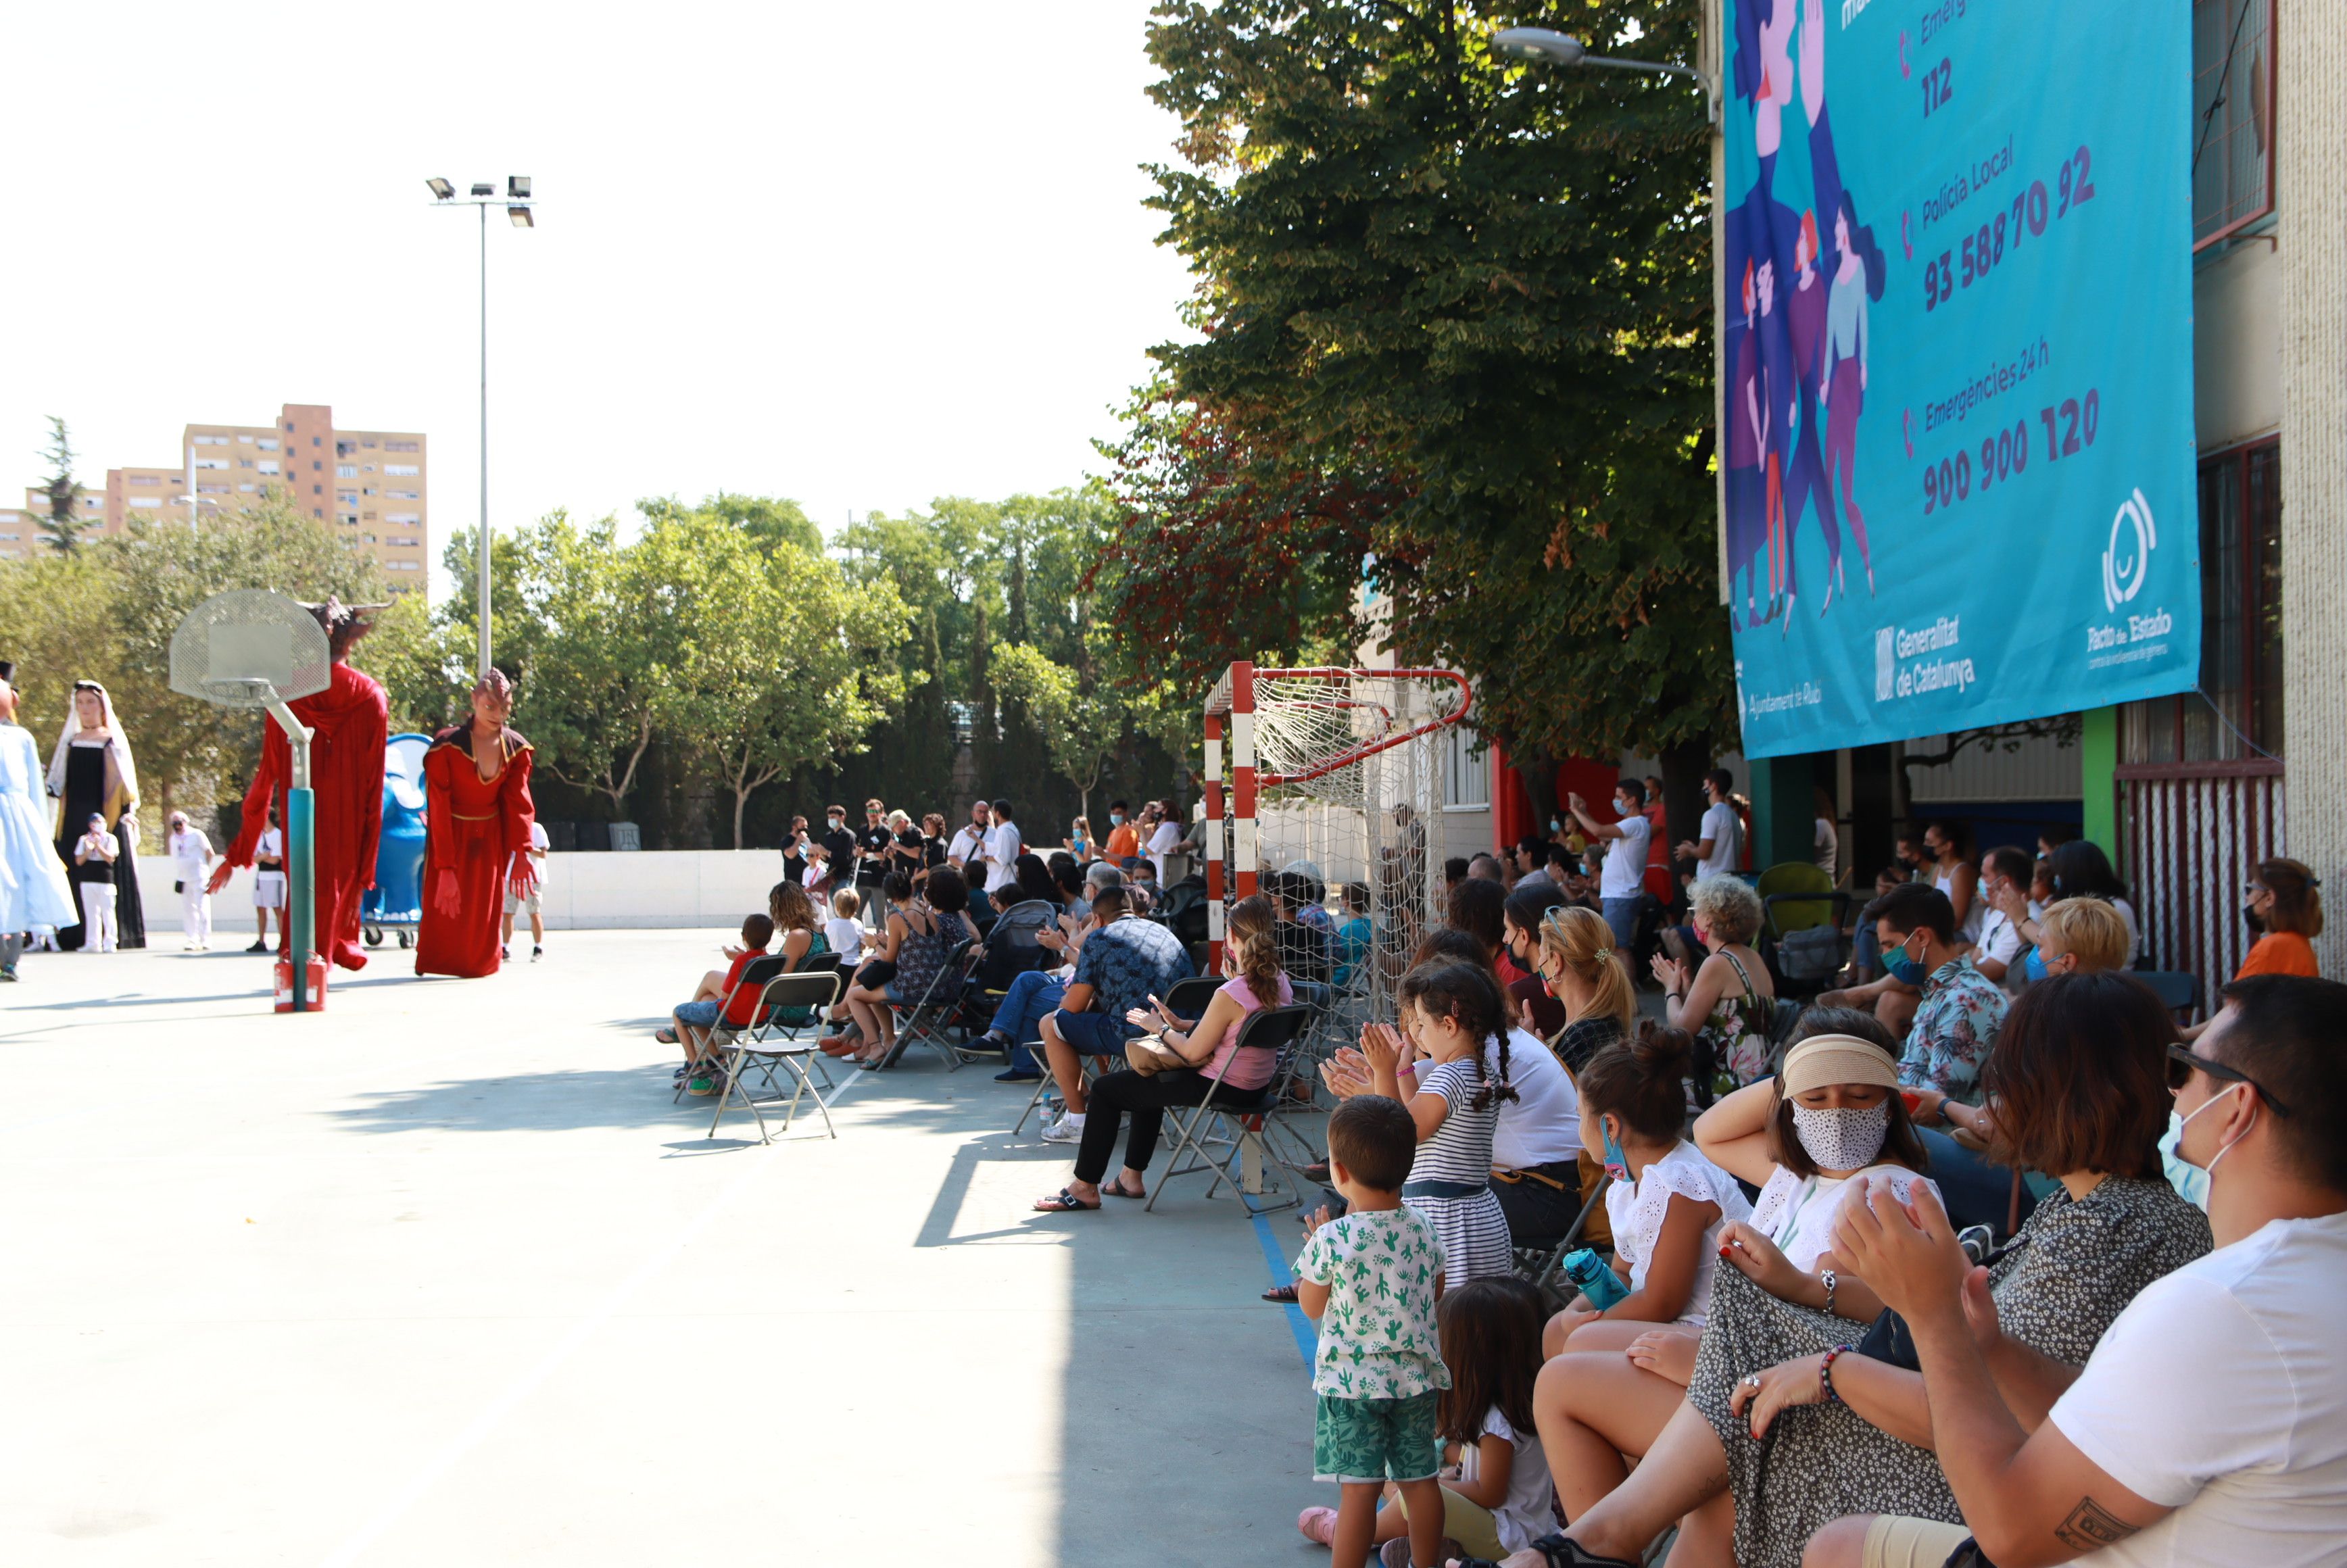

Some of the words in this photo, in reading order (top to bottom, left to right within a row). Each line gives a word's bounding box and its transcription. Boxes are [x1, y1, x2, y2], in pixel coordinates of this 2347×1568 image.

[1841, 0, 1872, 31] ma
[1922, 57, 1952, 119] 112
[1922, 173, 1968, 230] Policía
[1972, 132, 2012, 193] Local
[1924, 249, 1953, 313] 93
[1962, 211, 2007, 289] 588
[2012, 180, 2048, 250] 70
[2057, 145, 2095, 220] 92
[1925, 362, 2017, 433] Emergències
[1924, 449, 1971, 516] 900
[1981, 418, 2028, 491] 900
[2040, 387, 2100, 463] 120
[1896, 614, 1959, 660] Generalitat
[2087, 624, 2115, 652] Pacto
[2115, 627, 2128, 645] de
[2127, 606, 2172, 643] Estado
[1896, 667, 1912, 697] de
[1912, 658, 1976, 694] Catalunya
